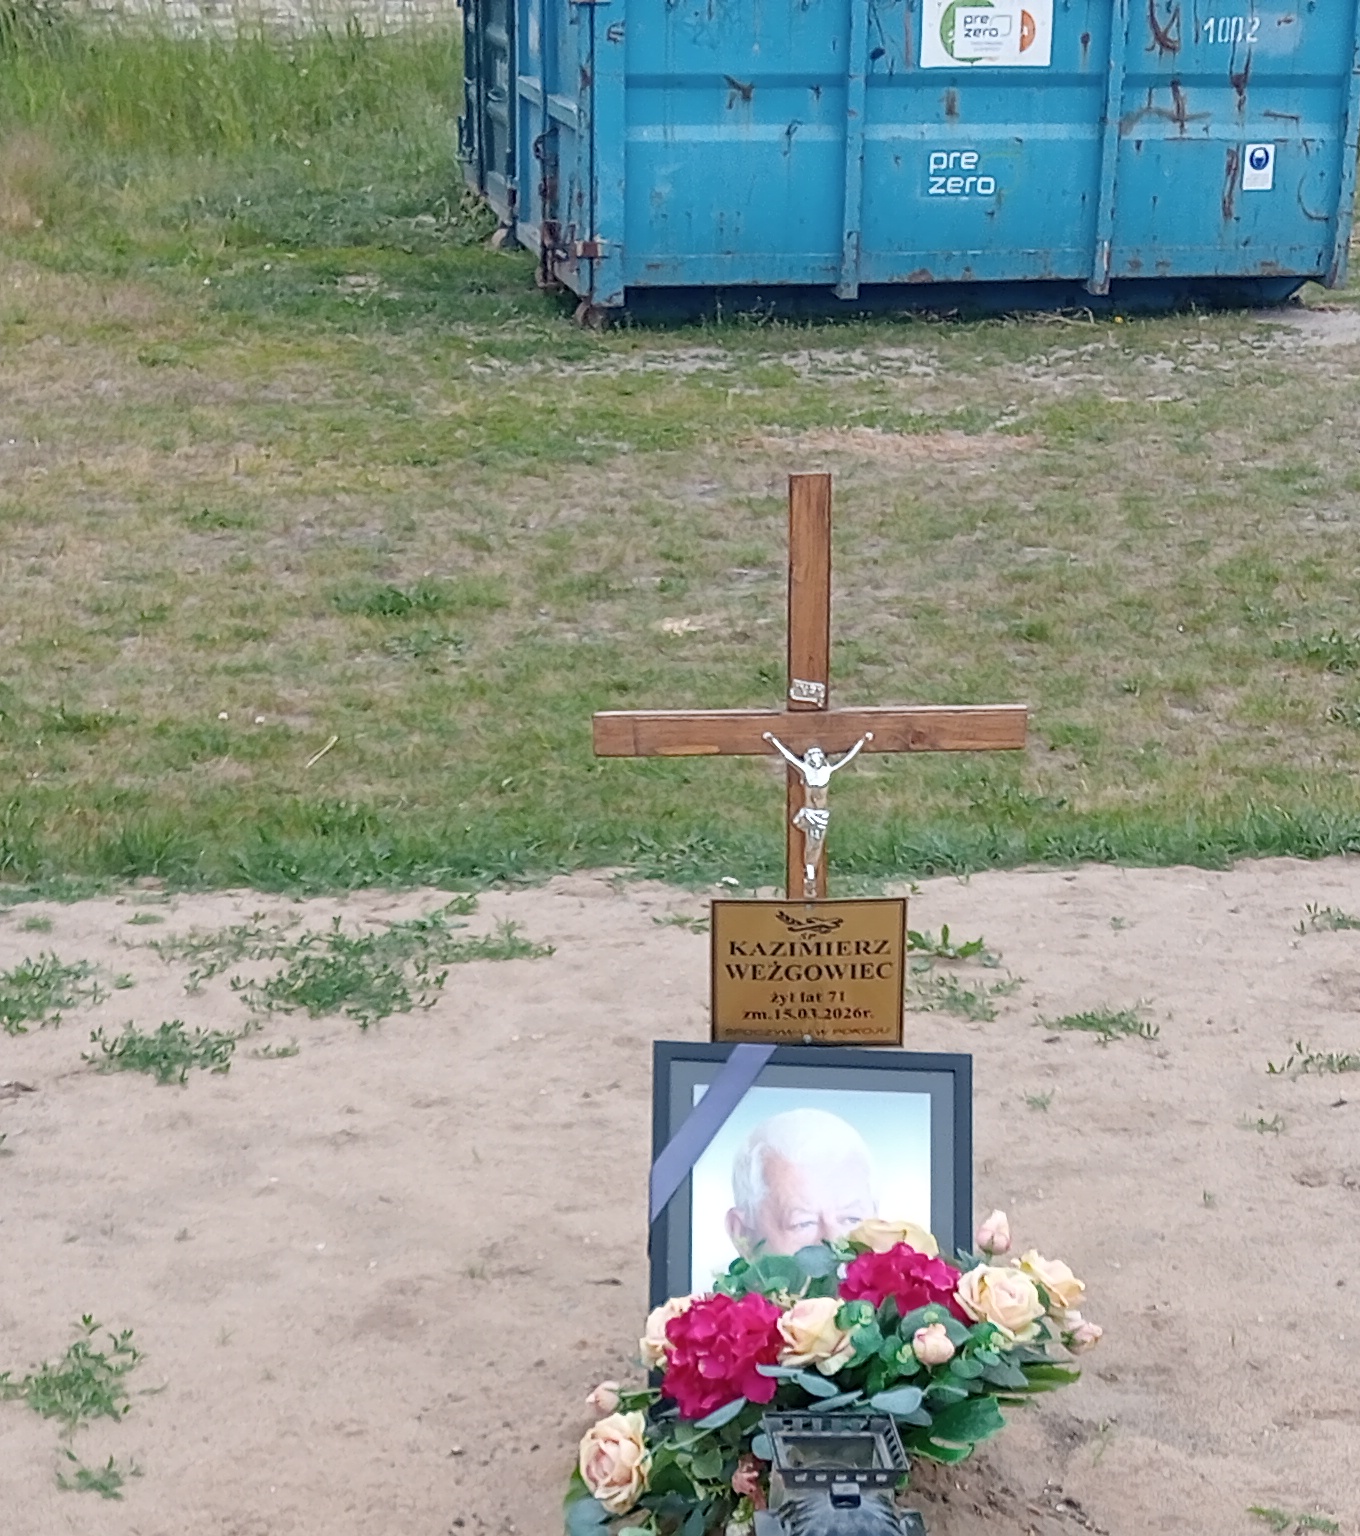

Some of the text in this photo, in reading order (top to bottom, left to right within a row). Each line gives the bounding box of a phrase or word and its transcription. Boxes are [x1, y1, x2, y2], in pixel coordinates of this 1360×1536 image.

[963, 15, 990, 26] pre
[1203, 16, 1261, 43] 1002
[963, 28, 999, 38] zero
[929, 151, 978, 175] pre
[928, 176, 995, 195] zero
[729, 940, 891, 957] KAZIMIERZ
[725, 961, 893, 982] WEŻGOWIEC
[800, 990, 823, 1004] lat
[827, 990, 846, 1003] 71
